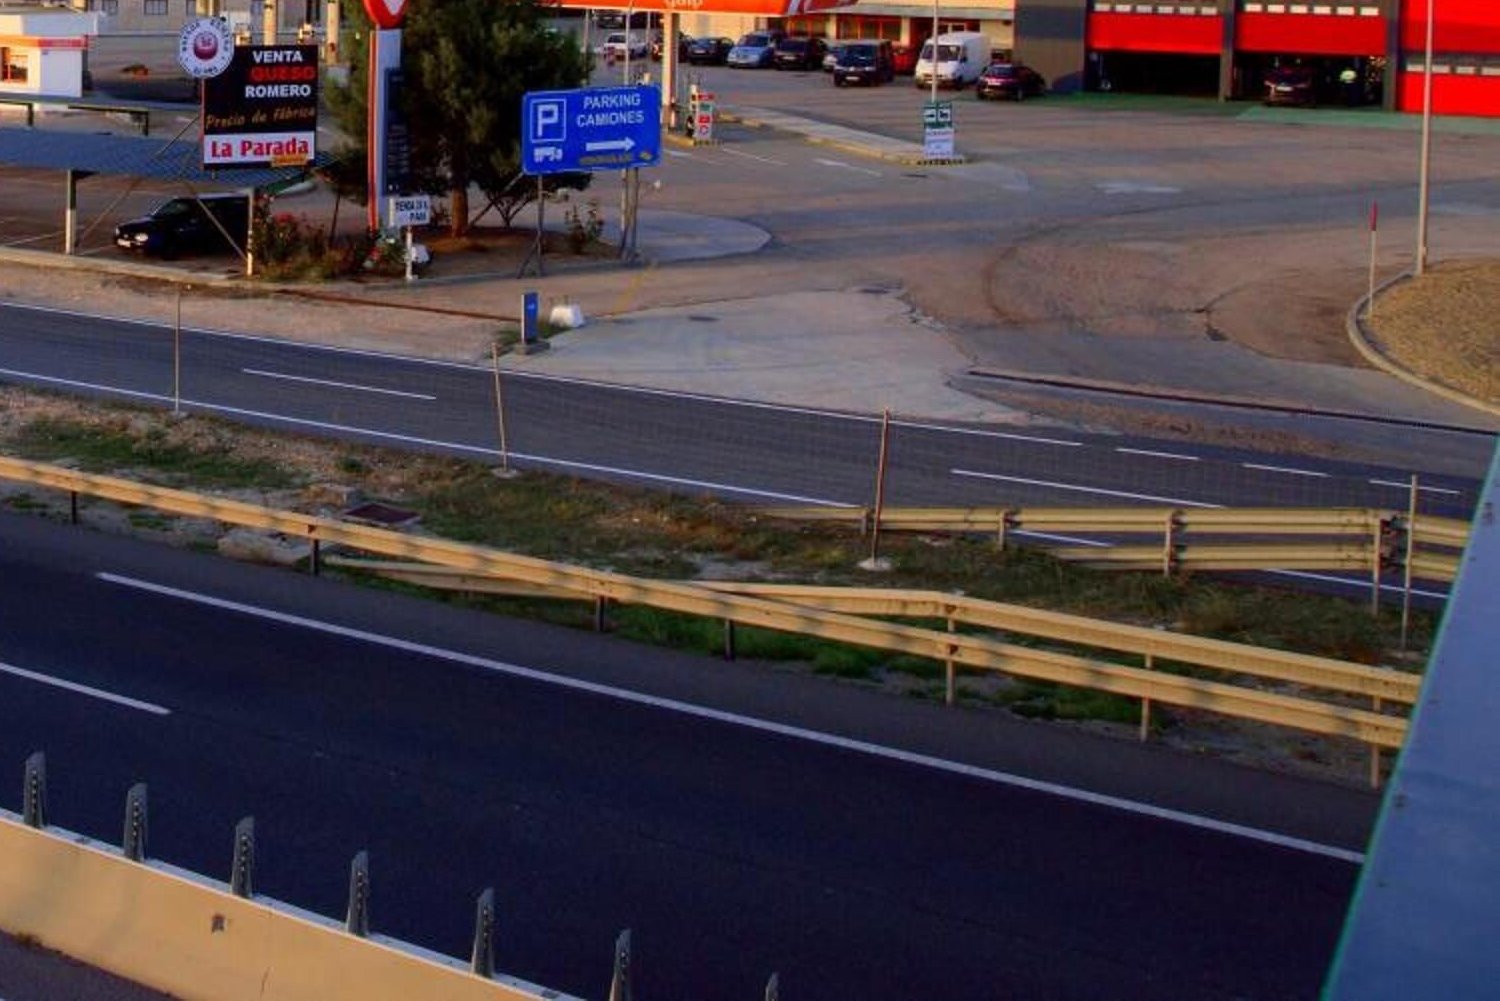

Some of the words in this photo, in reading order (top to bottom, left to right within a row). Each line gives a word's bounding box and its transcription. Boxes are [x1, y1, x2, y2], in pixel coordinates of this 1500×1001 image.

[252, 50, 303, 64] VENTA
[251, 65, 316, 81] QUESO
[244, 83, 311, 98] ROMERO
[583, 92, 642, 110] PARKING
[576, 110, 645, 128] CAMIONES
[211, 141, 233, 158] La
[241, 136, 309, 157] Parada
